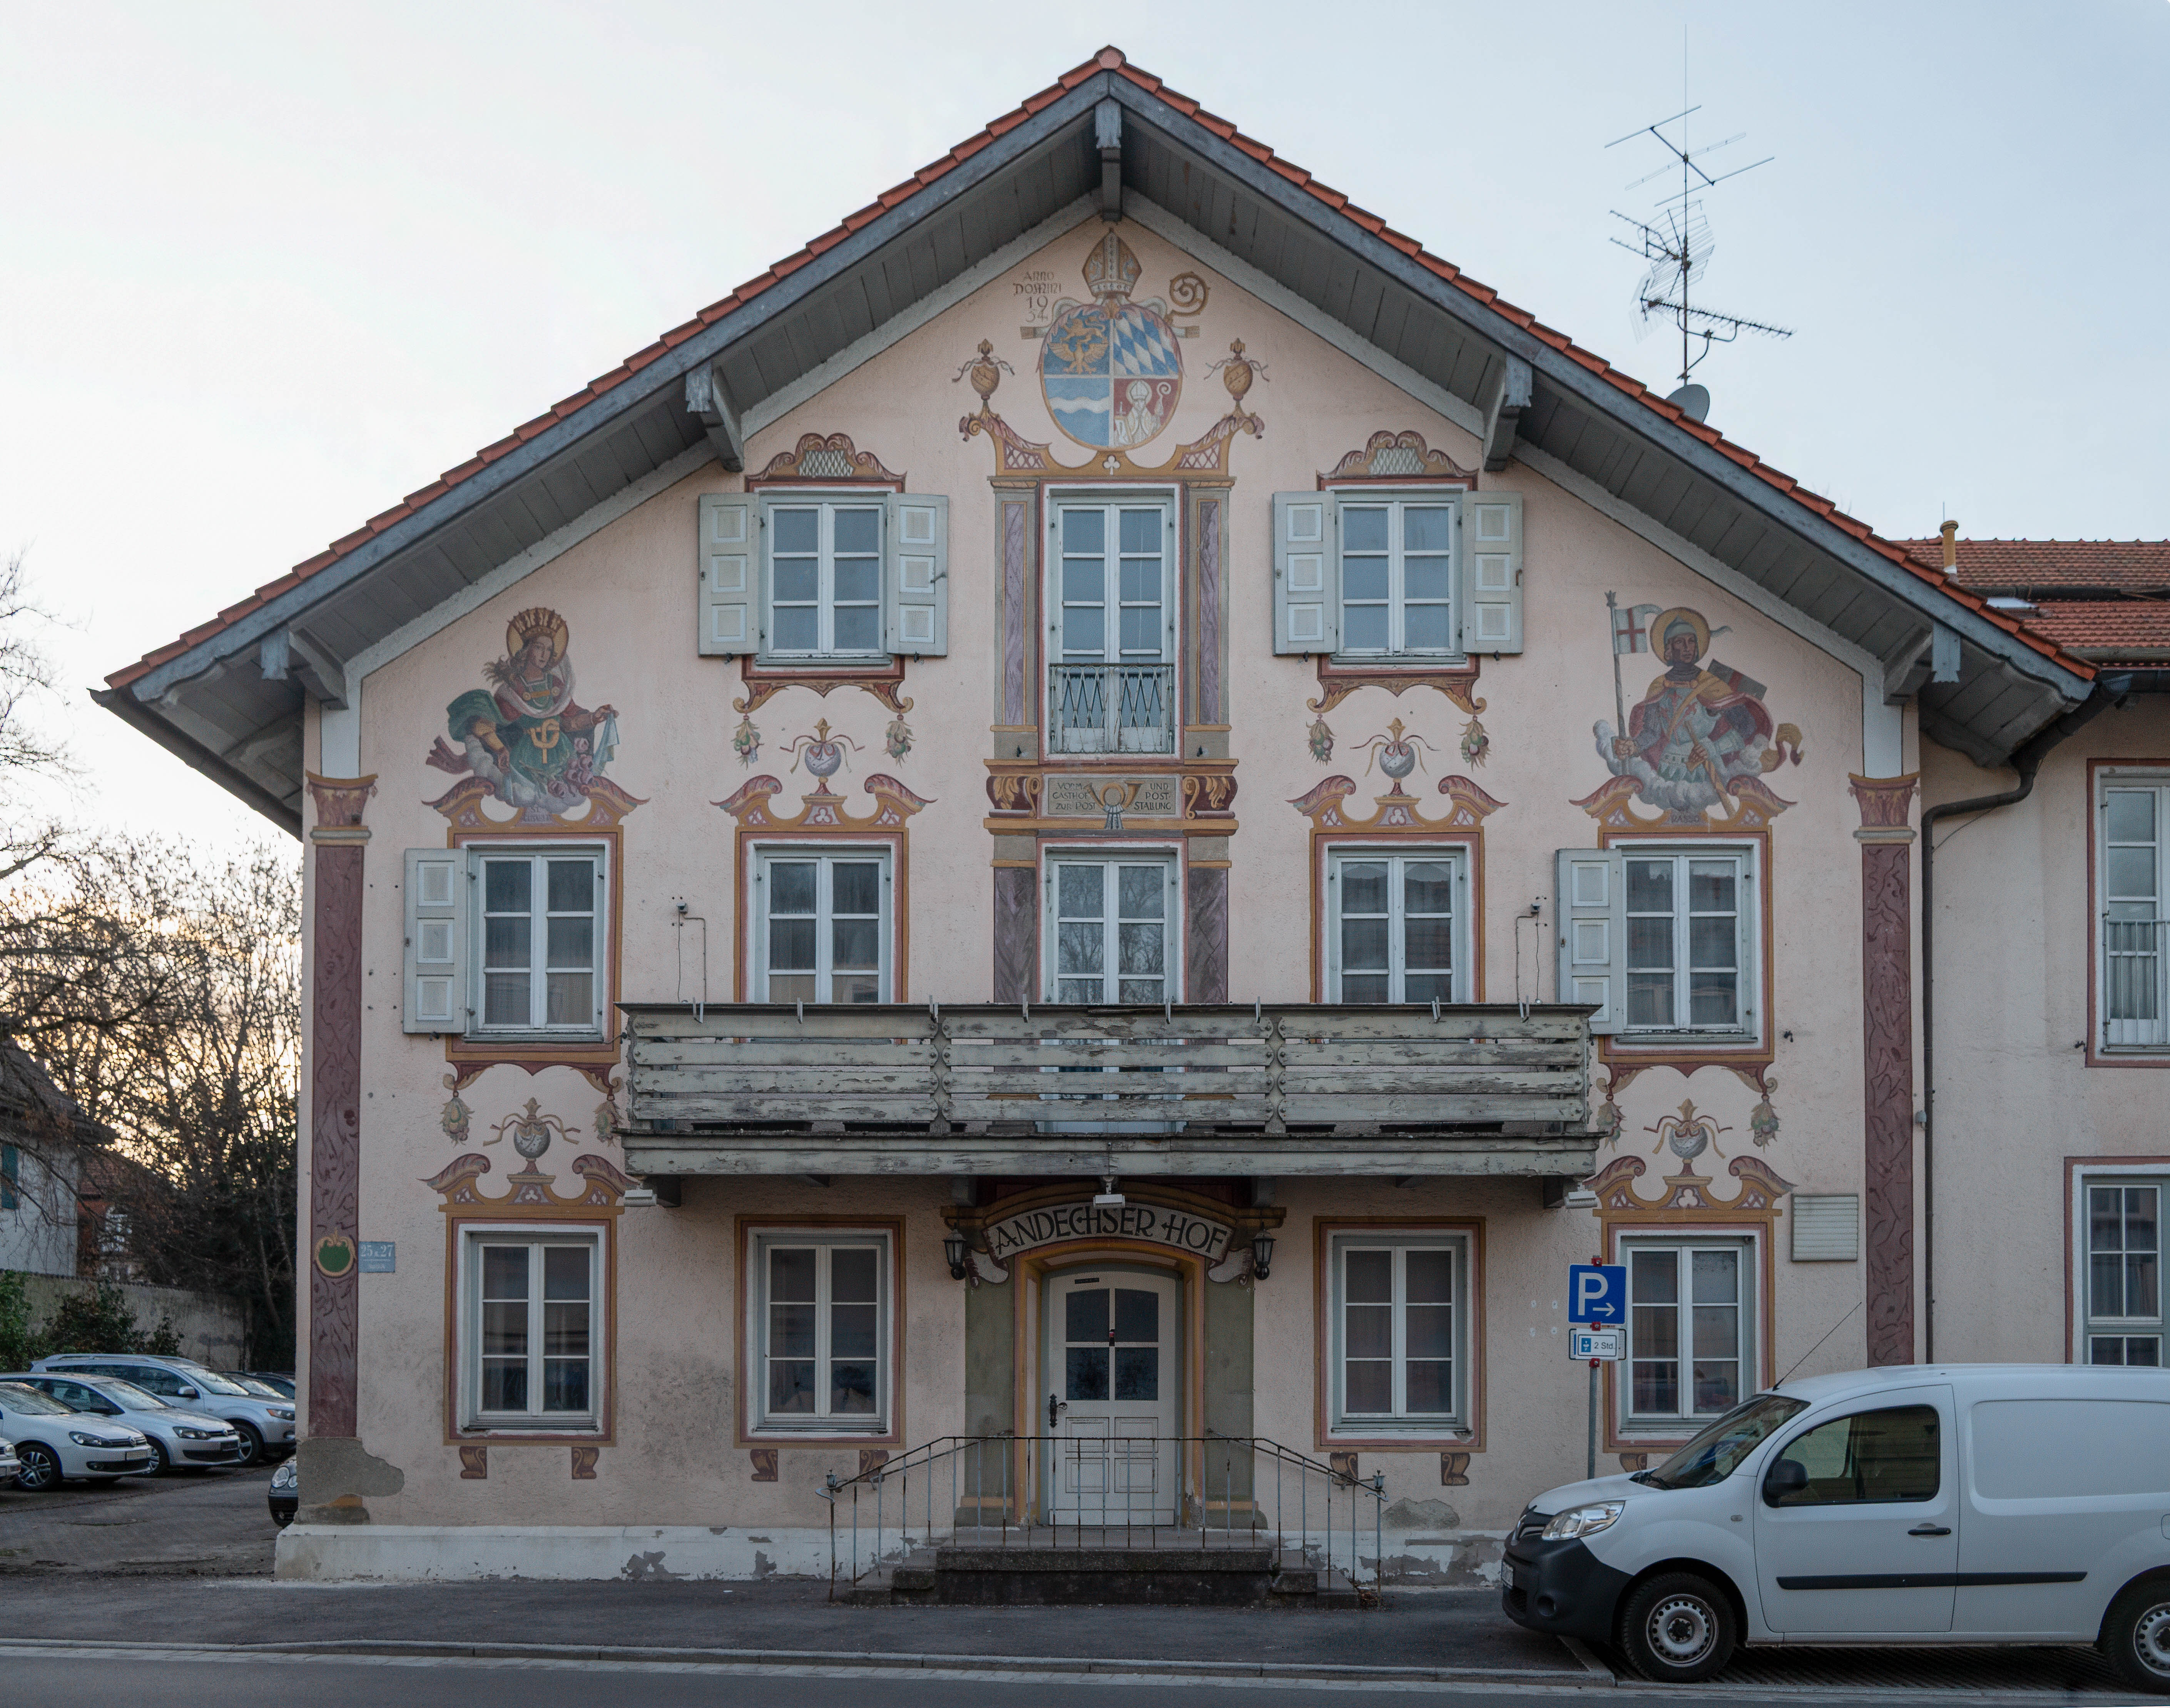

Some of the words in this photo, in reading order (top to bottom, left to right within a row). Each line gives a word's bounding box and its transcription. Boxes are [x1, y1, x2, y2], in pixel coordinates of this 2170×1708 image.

[1013, 283, 1062, 296] DOMINI
[1025, 295, 1048, 310] 19
[1075, 802, 1096, 810] POST
[995, 1205, 1155, 1255] ANDECHSER
[1160, 1214, 1227, 1253] HOF
[1578, 1272, 1608, 1316] P
